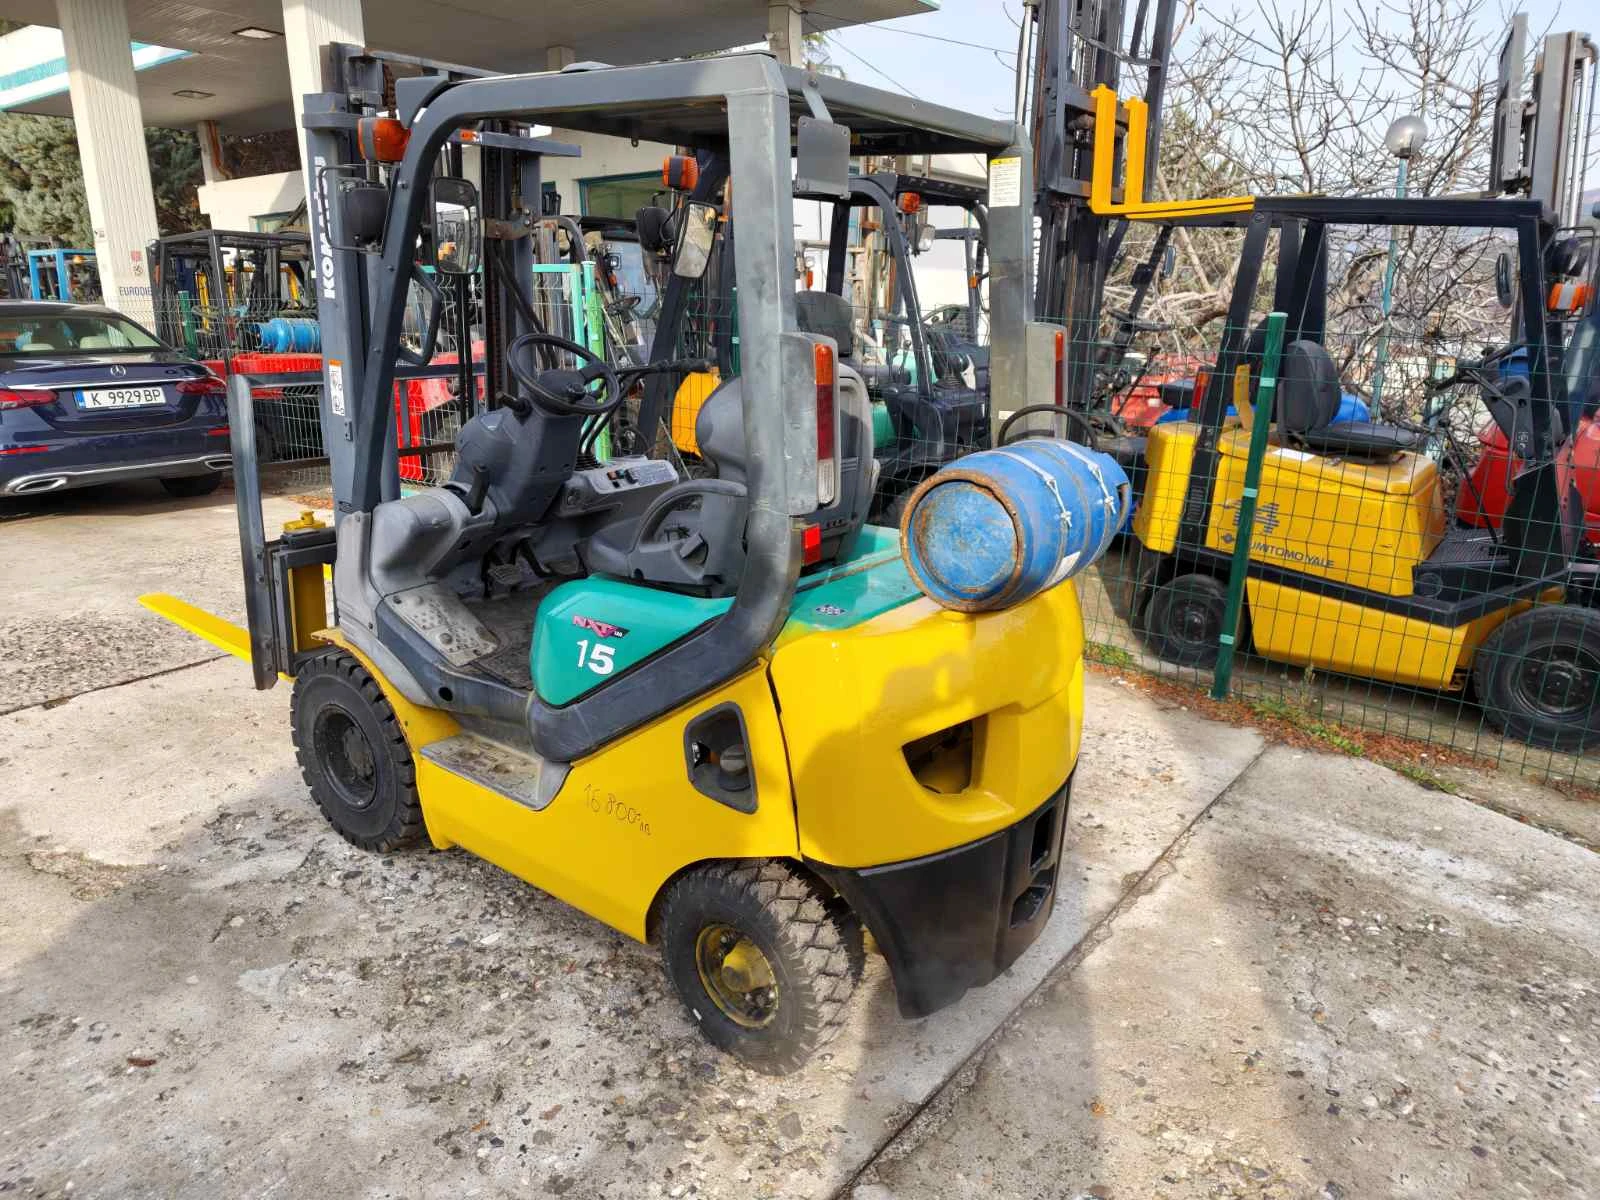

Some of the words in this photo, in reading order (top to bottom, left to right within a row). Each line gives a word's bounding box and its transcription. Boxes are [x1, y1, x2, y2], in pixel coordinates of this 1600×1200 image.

[91, 393, 102, 406] K
[108, 391, 141, 404] 9929
[143, 389, 161, 402] BP
[576, 639, 616, 675] 15
